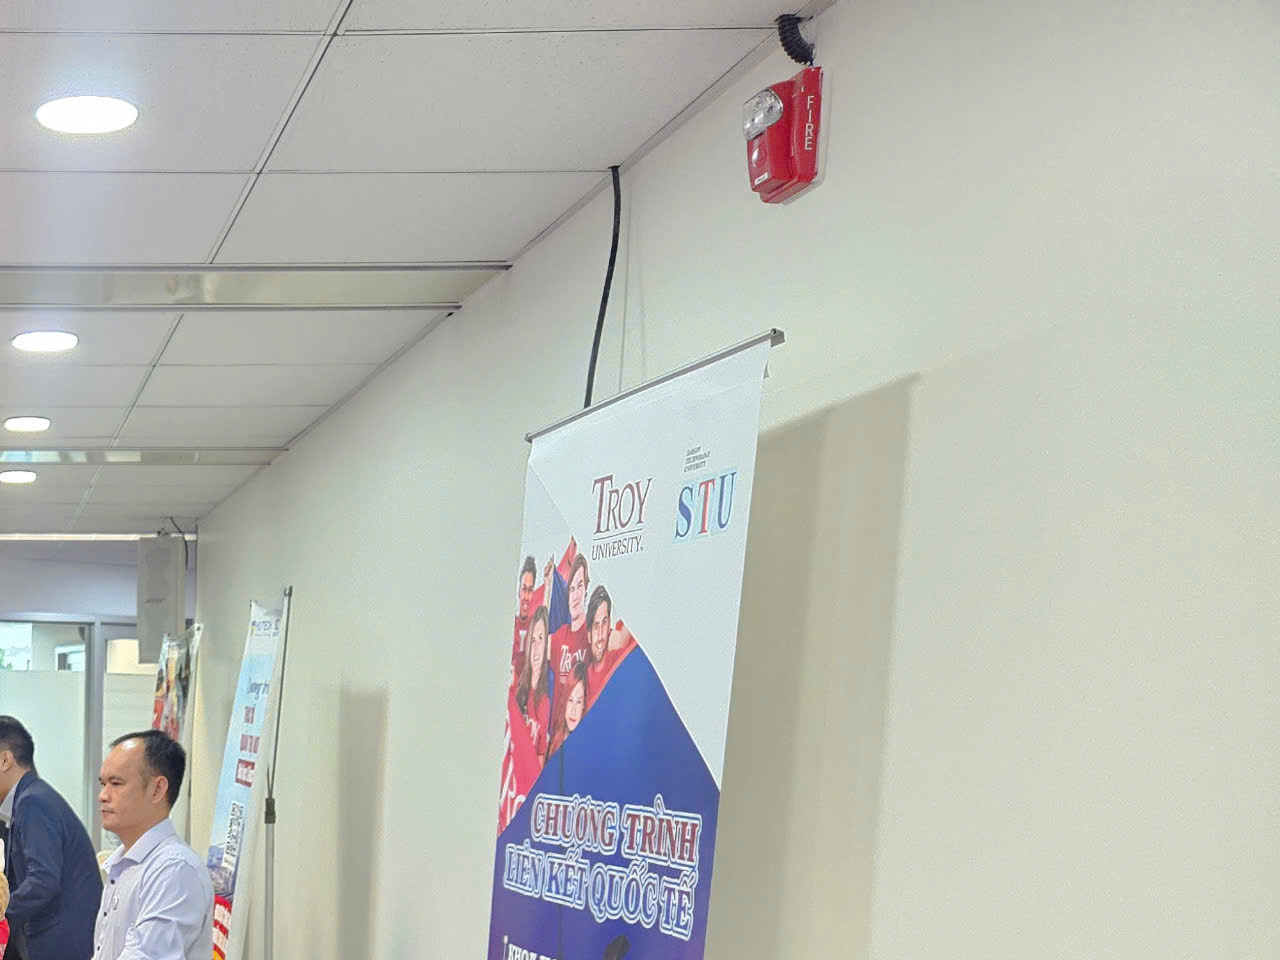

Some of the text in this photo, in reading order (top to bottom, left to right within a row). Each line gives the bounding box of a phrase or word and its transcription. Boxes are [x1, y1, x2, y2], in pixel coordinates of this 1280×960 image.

[805, 95, 815, 150] FIRE
[592, 474, 653, 535] TROY
[674, 471, 737, 540] STU
[621, 794, 702, 866] TRÌNH
